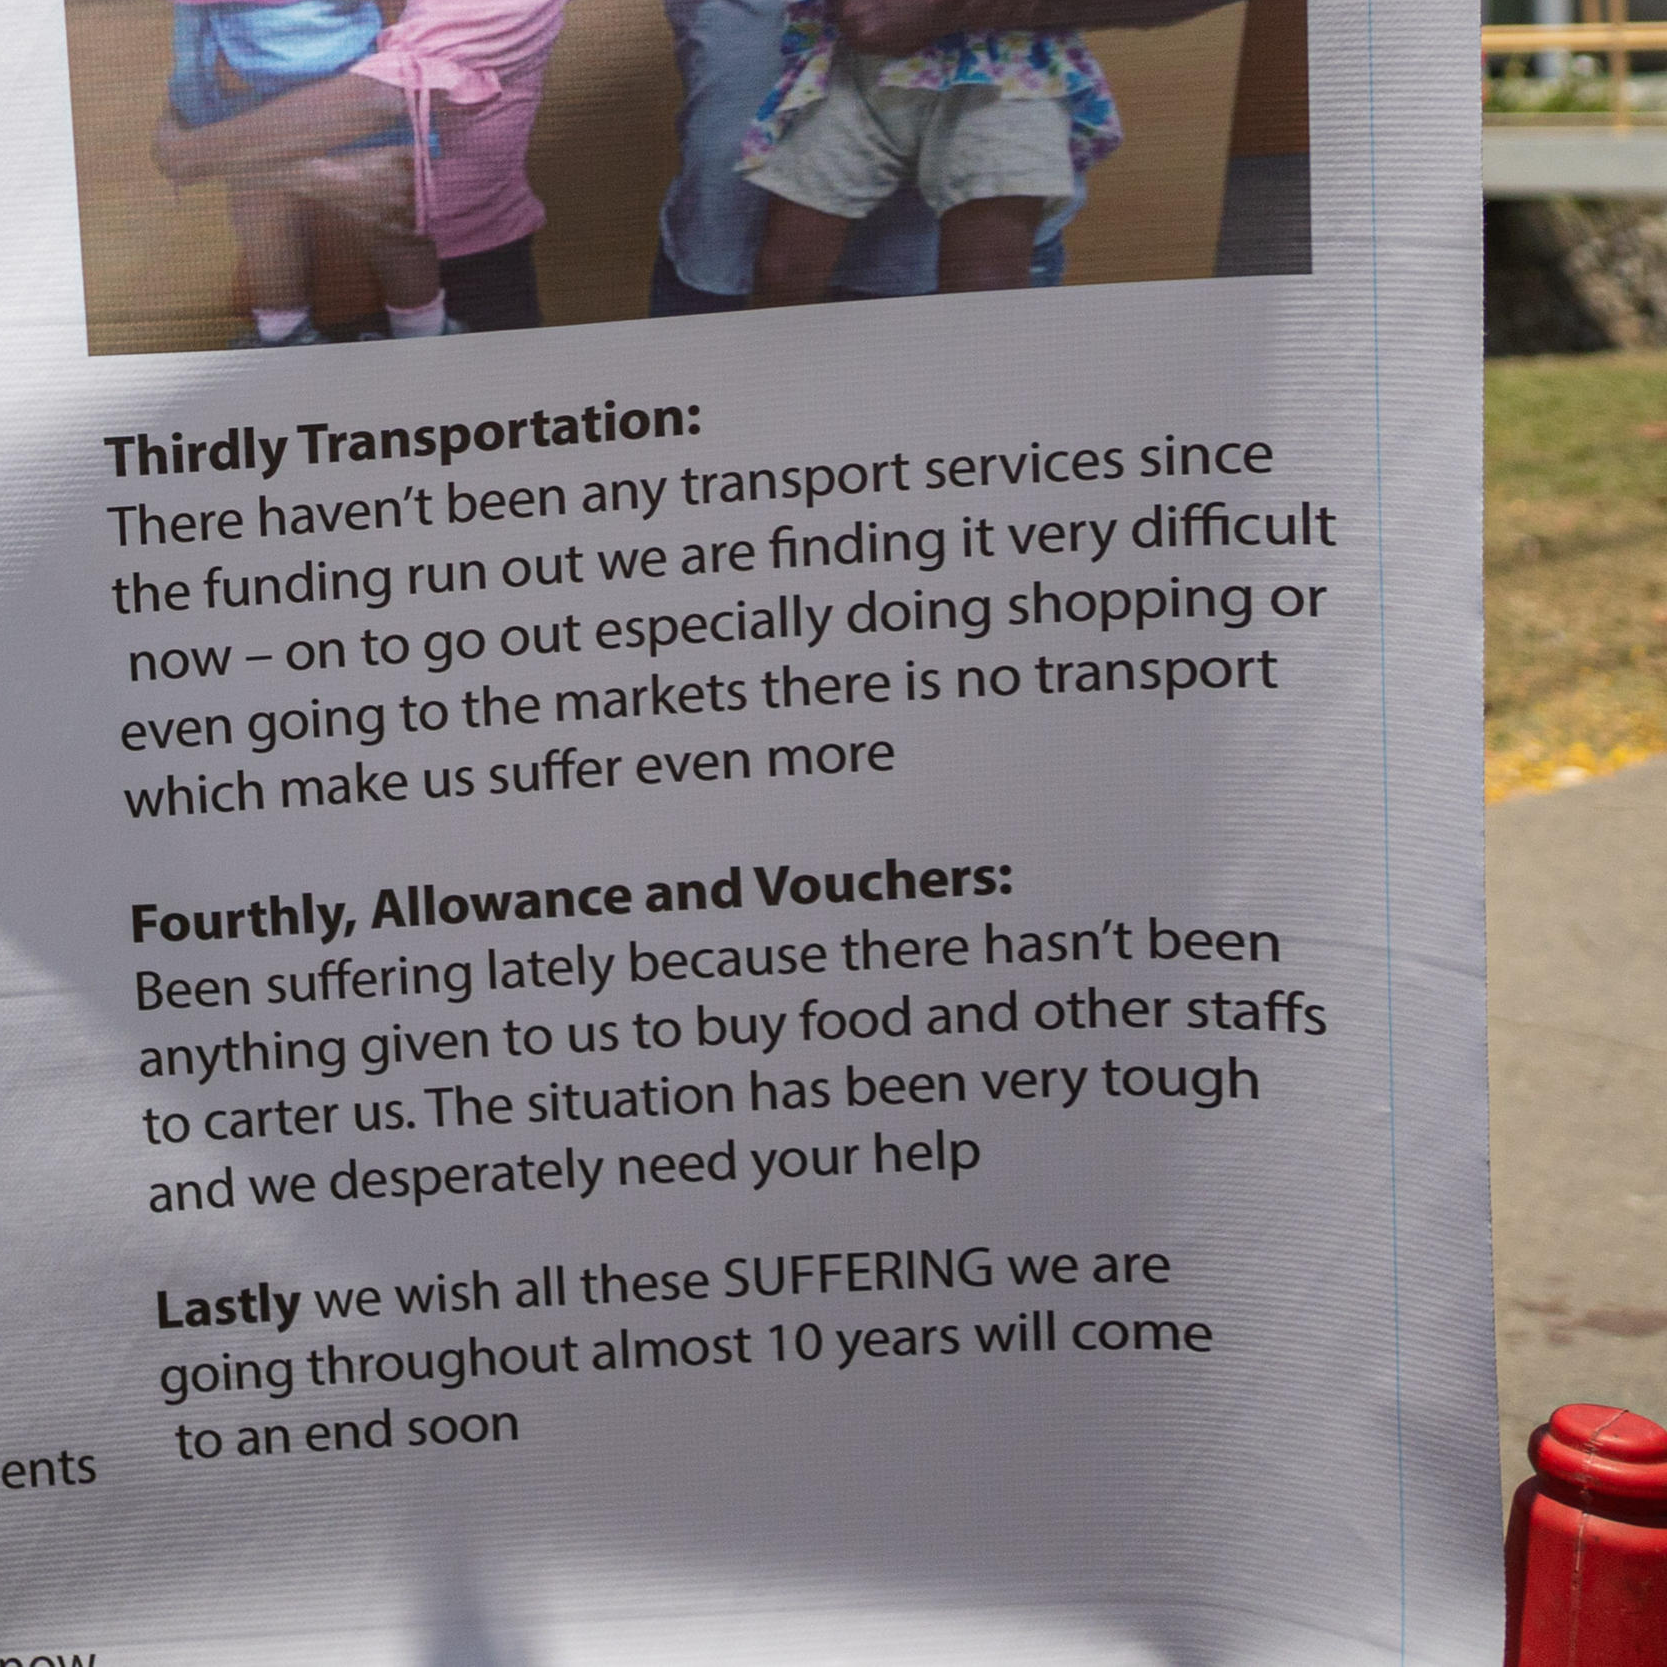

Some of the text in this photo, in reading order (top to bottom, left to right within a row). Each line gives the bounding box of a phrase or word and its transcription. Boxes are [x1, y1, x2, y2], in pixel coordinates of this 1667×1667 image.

[103, 399, 701, 481] Thirdly Transportation:
[106, 434, 1274, 547] There haven't been any transport services since
[111, 500, 1337, 615] the funding run out we are finding it very difficult
[131, 857, 1013, 946] Fourthly, Allowance and Vouchers:
[136, 916, 1280, 1011] Been suffering lately because there hasn't been
[139, 986, 1327, 1086] anything given to us to buy food and other staffs
[149, 1128, 981, 1214] and we desperately need your help
[156, 1246, 1171, 1334] Lastly we wish all these SUFFERING we are
[160, 1309, 1213, 1407] going throughout almost 10 years will come
[174, 1407, 519, 1461] to an end soon
